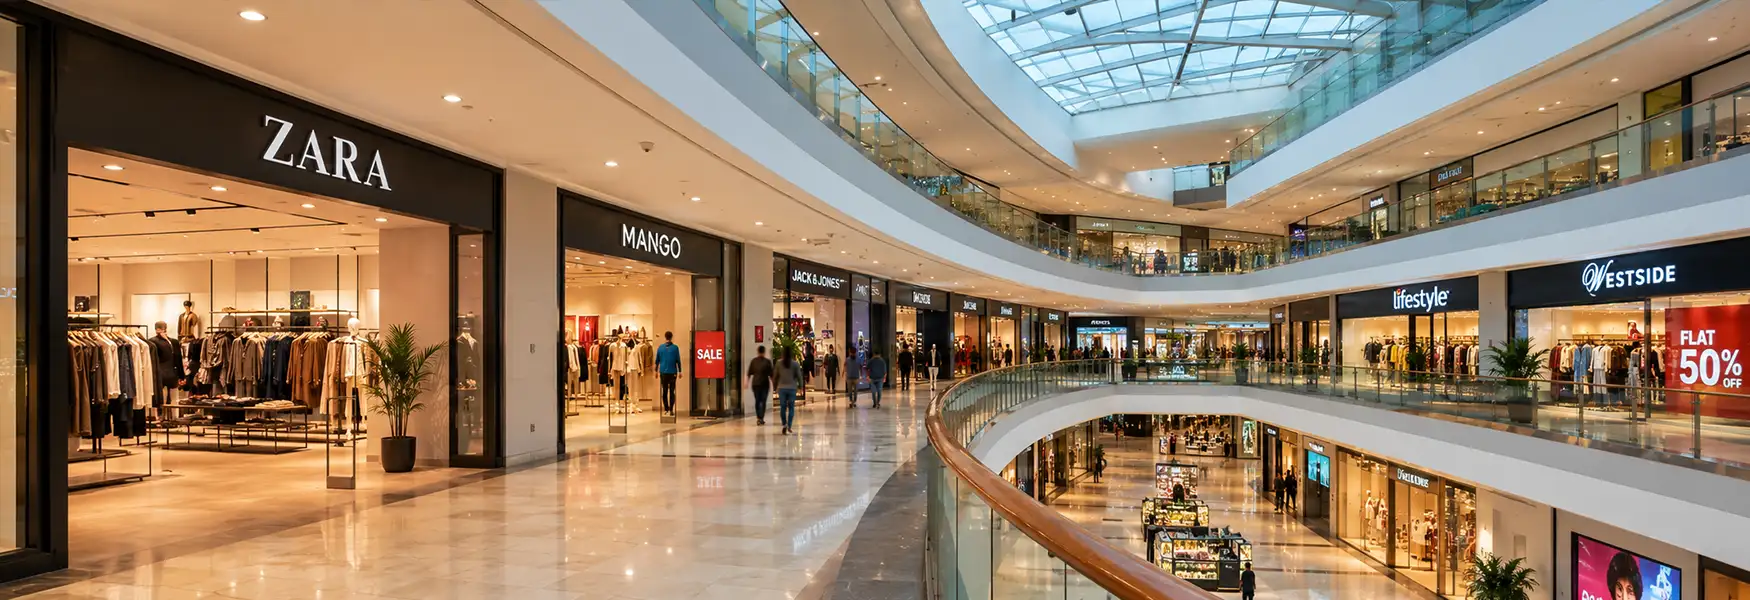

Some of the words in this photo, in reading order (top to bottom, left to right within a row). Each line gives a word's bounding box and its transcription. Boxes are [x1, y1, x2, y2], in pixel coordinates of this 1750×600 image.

[262, 114, 392, 192] ZARA
[622, 223, 681, 259] MANGO
[792, 269, 812, 285] JACK
[817, 275, 841, 290] JONES
[1393, 285, 1449, 313] lifestyle
[1680, 329, 1716, 346] FLAT
[697, 348, 723, 360] SALE
[1679, 348, 1743, 386] 50%
[1722, 377, 1743, 389] OFF
